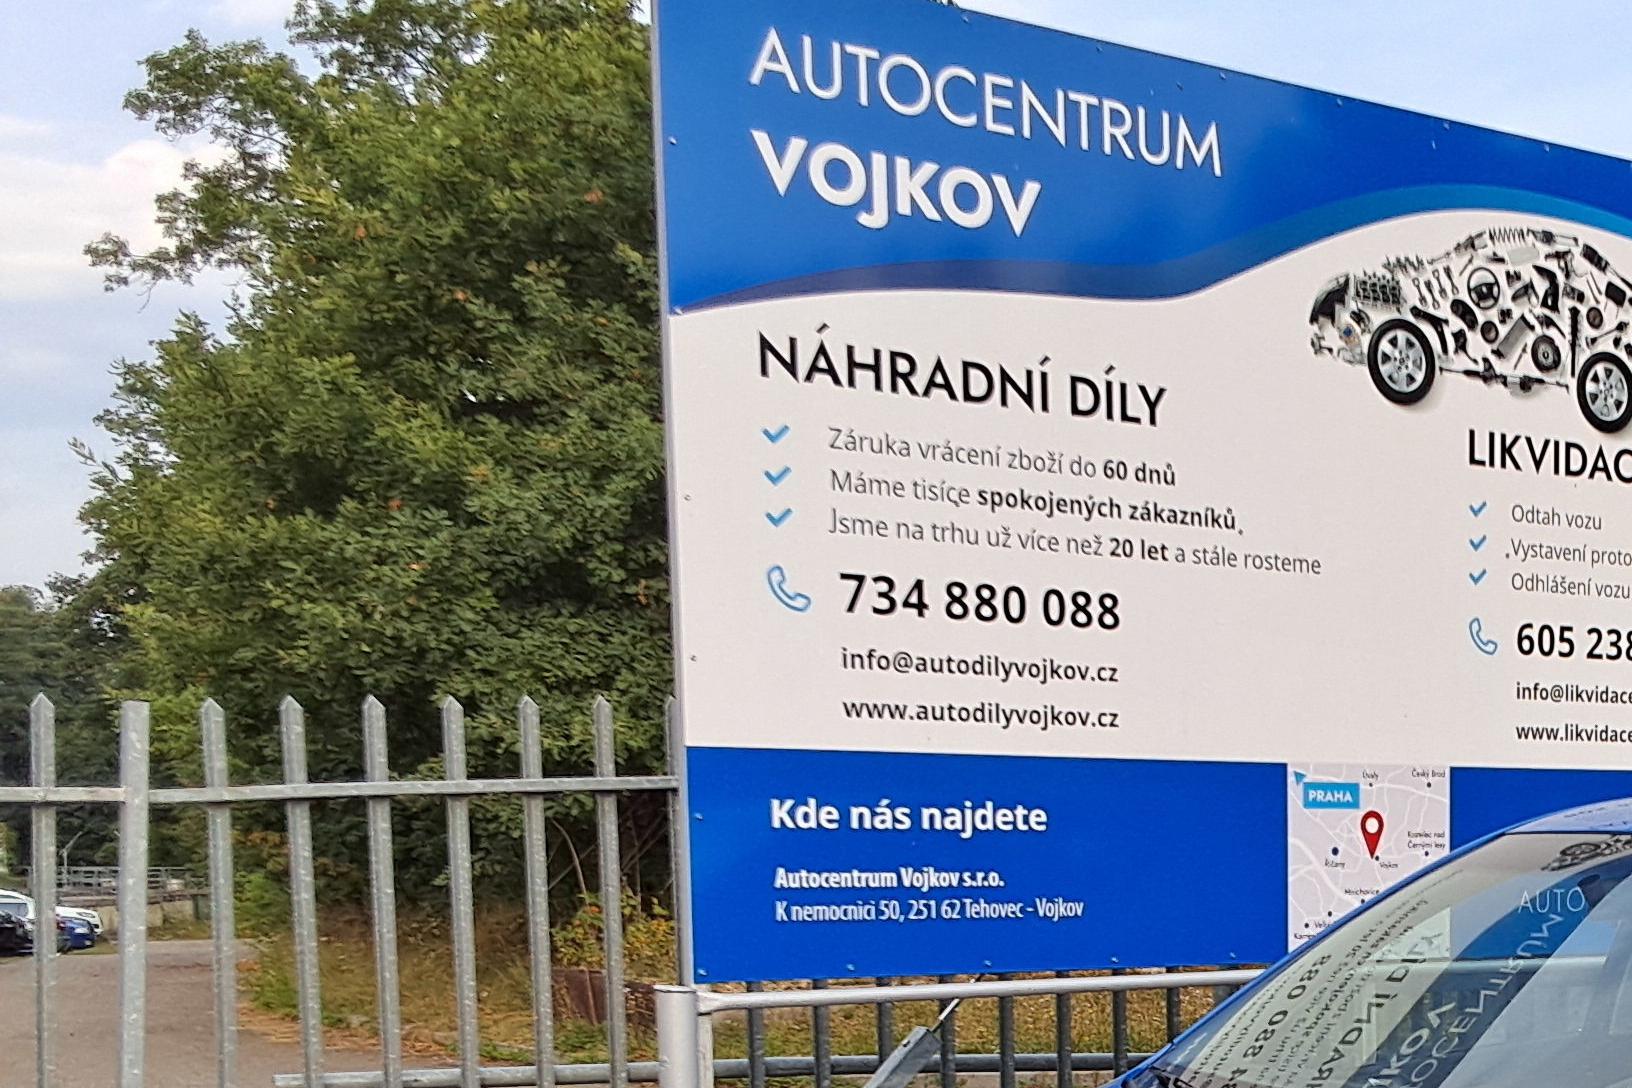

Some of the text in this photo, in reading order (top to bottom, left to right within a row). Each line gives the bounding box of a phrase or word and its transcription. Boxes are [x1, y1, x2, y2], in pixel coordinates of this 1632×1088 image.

[749, 26, 1223, 178] AUTOCENTRUM
[750, 129, 1042, 238] VOJKOV
[758, 323, 1167, 427] NÁHRADNÍ DÍLY
[828, 426, 1176, 487] Záruka vrácení zboží do 60 dnů
[830, 469, 905, 498] Máme
[978, 487, 1122, 521] spokojených
[1511, 504, 1602, 530] Odtah vozu
[829, 507, 1321, 575] Jsme na trhu už více než 20 let a stále rosteme
[839, 572, 1120, 630] 734 880 088
[1511, 573, 1591, 597] Odhlášení
[1595, 582, 1630, 600] vozu
[1517, 623, 1575, 658] 605
[841, 647, 1119, 685] info@autodilyvojkov.cz
[842, 701, 1120, 731] www.autodilyvojkov.cz
[1308, 789, 1353, 803] PRAHA
[770, 797, 1048, 839] Kde nás najdete
[774, 867, 1004, 892] Autocentrum Vojkov s.r.o.
[775, 899, 788, 922] K
[790, 900, 876, 921] nemocnici
[878, 899, 905, 923] 50,
[908, 899, 936, 920] 251
[941, 899, 961, 919] 62
[964, 897, 1024, 919] Tehovec
[1035, 897, 1084, 921] Vojkov
